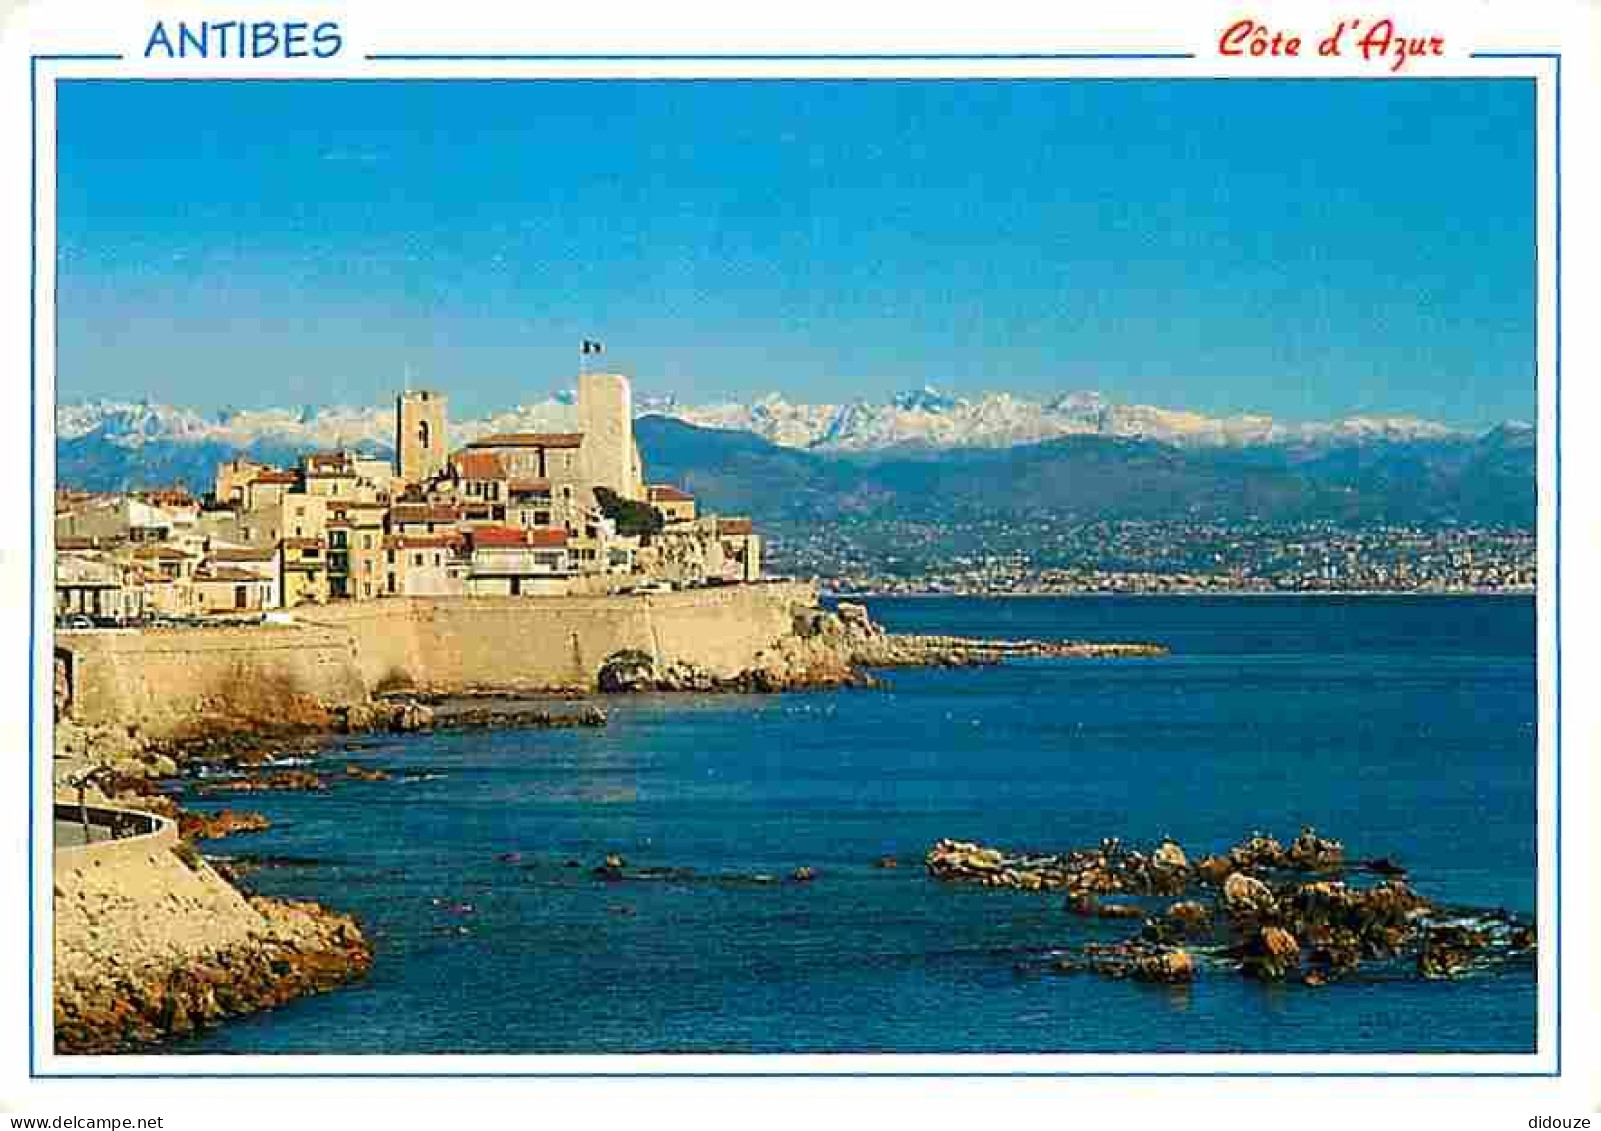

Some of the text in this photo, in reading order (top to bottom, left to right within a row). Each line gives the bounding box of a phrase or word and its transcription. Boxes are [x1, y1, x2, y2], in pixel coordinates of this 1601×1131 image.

[144, 21, 342, 59] ANTIBES
[1218, 18, 1446, 71] Côte d'Azur
